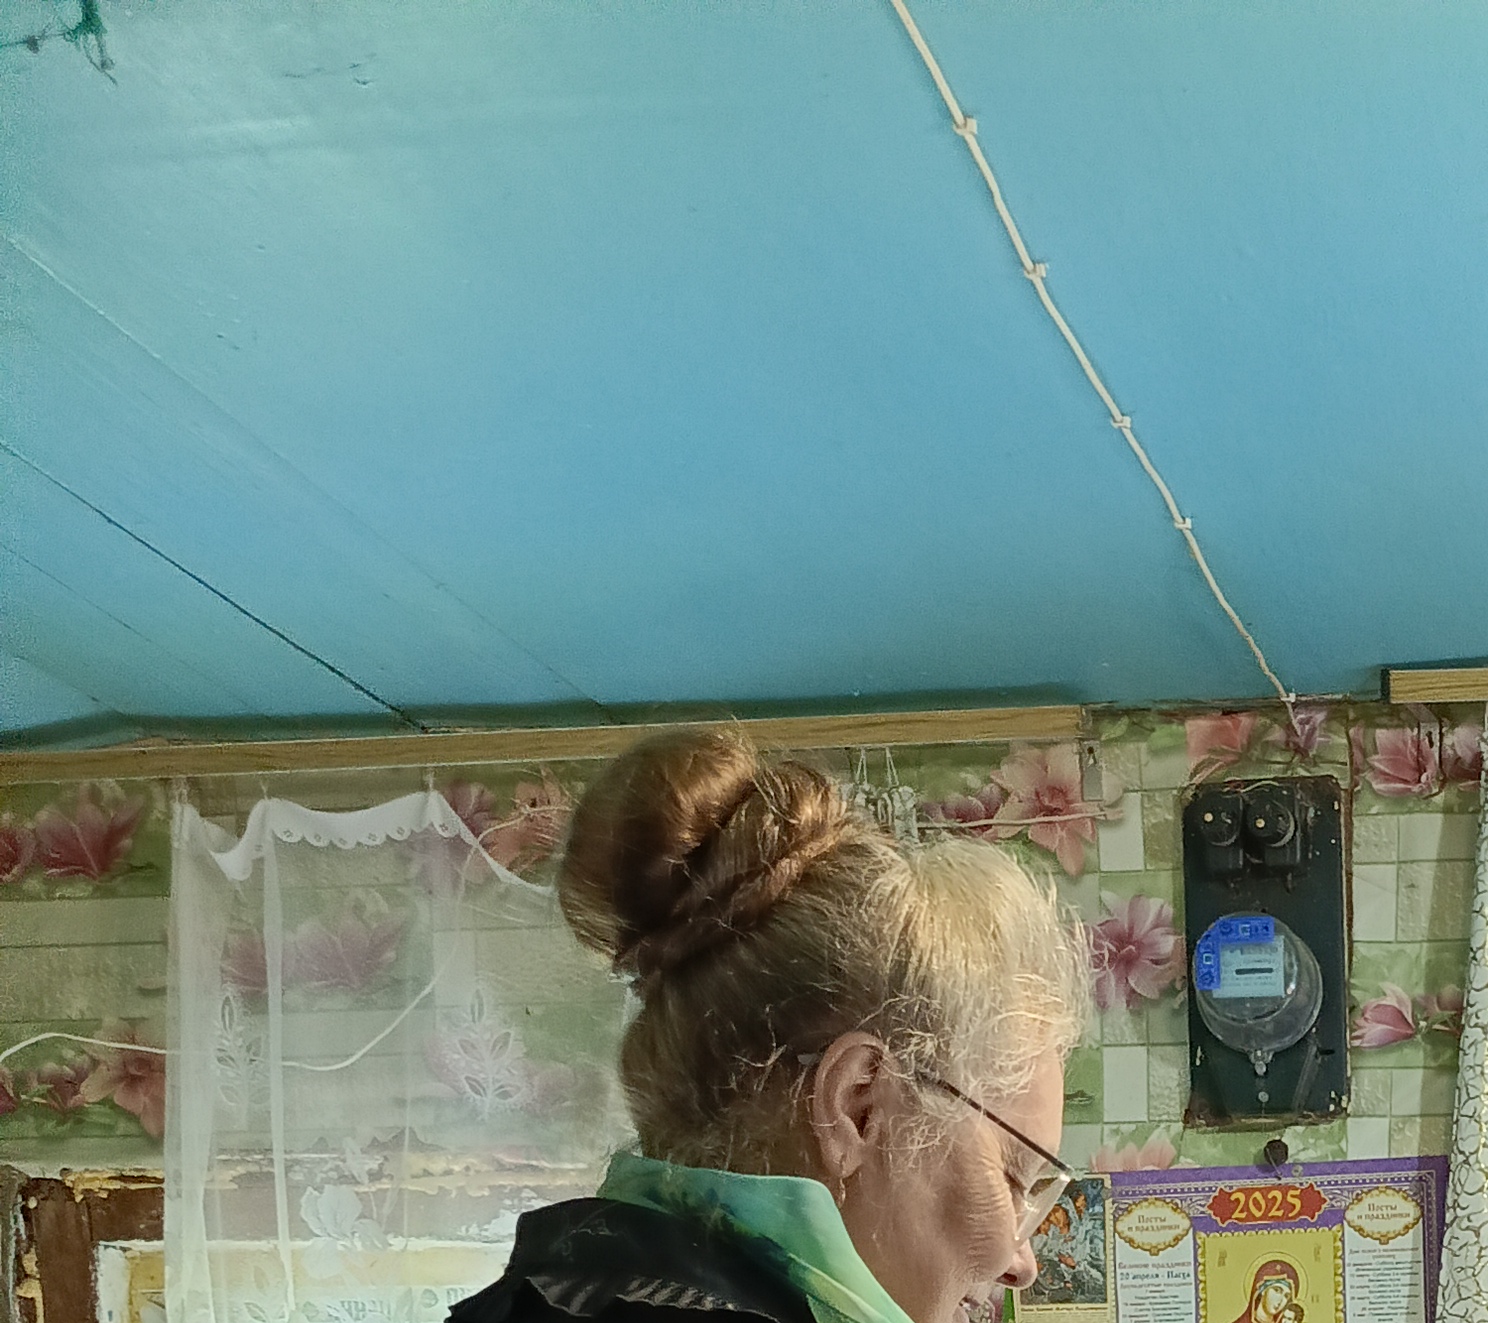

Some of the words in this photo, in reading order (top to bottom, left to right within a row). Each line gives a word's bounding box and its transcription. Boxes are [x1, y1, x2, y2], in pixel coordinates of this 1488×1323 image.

[1229, 1189, 1302, 1219] 2025
[1367, 1203, 1398, 1212] Посты
[1137, 1215, 1167, 1224] Посты
[1364, 1212, 1411, 1221] праздники
[1135, 1224, 1180, 1232] праздники
